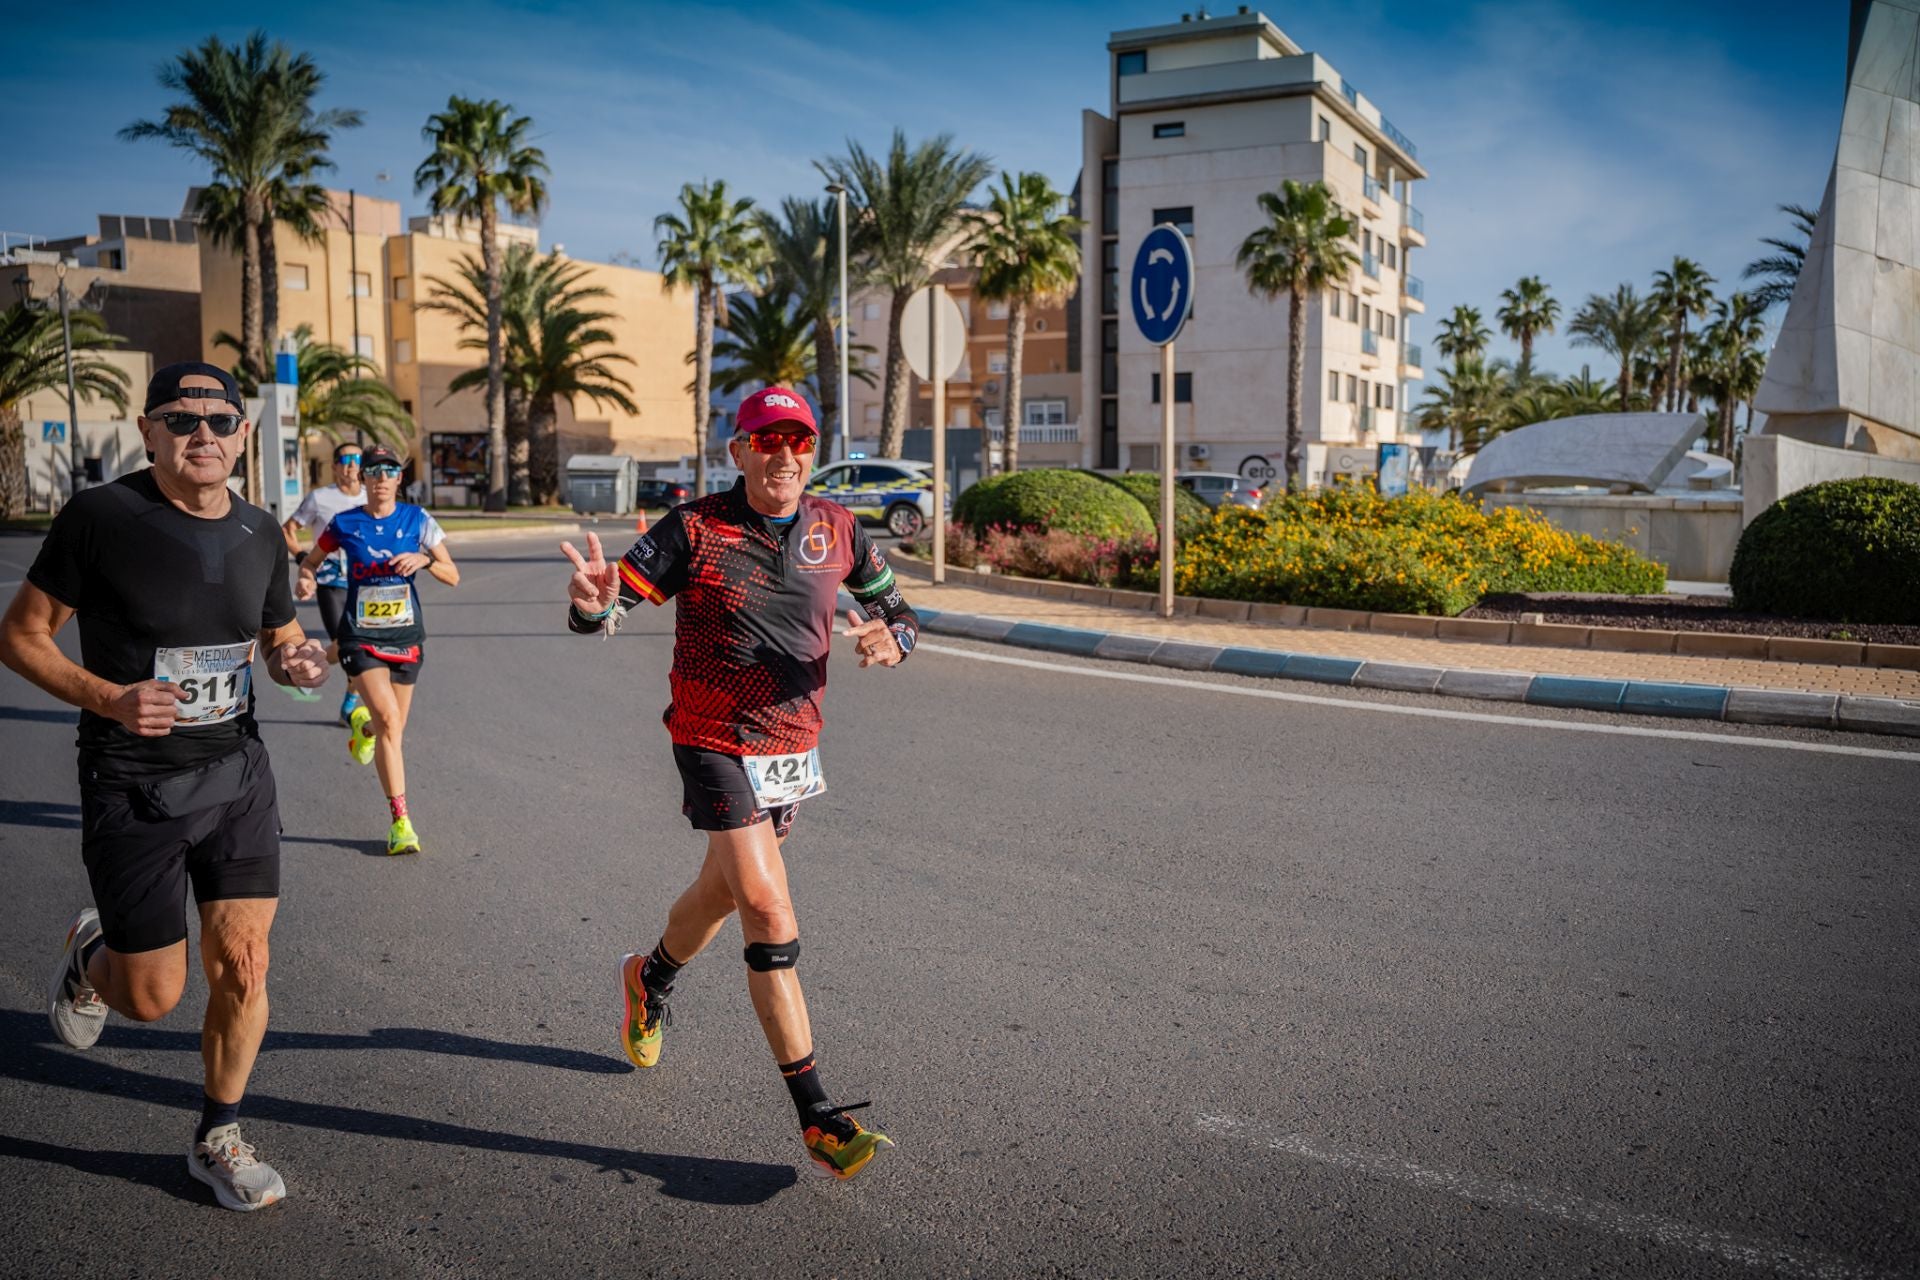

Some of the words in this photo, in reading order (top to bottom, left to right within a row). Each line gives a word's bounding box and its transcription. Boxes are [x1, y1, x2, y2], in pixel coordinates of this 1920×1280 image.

[368, 602, 402, 617] 227
[194, 648, 232, 662] MEDIA
[179, 675, 237, 705] 611
[764, 756, 808, 785] 421
